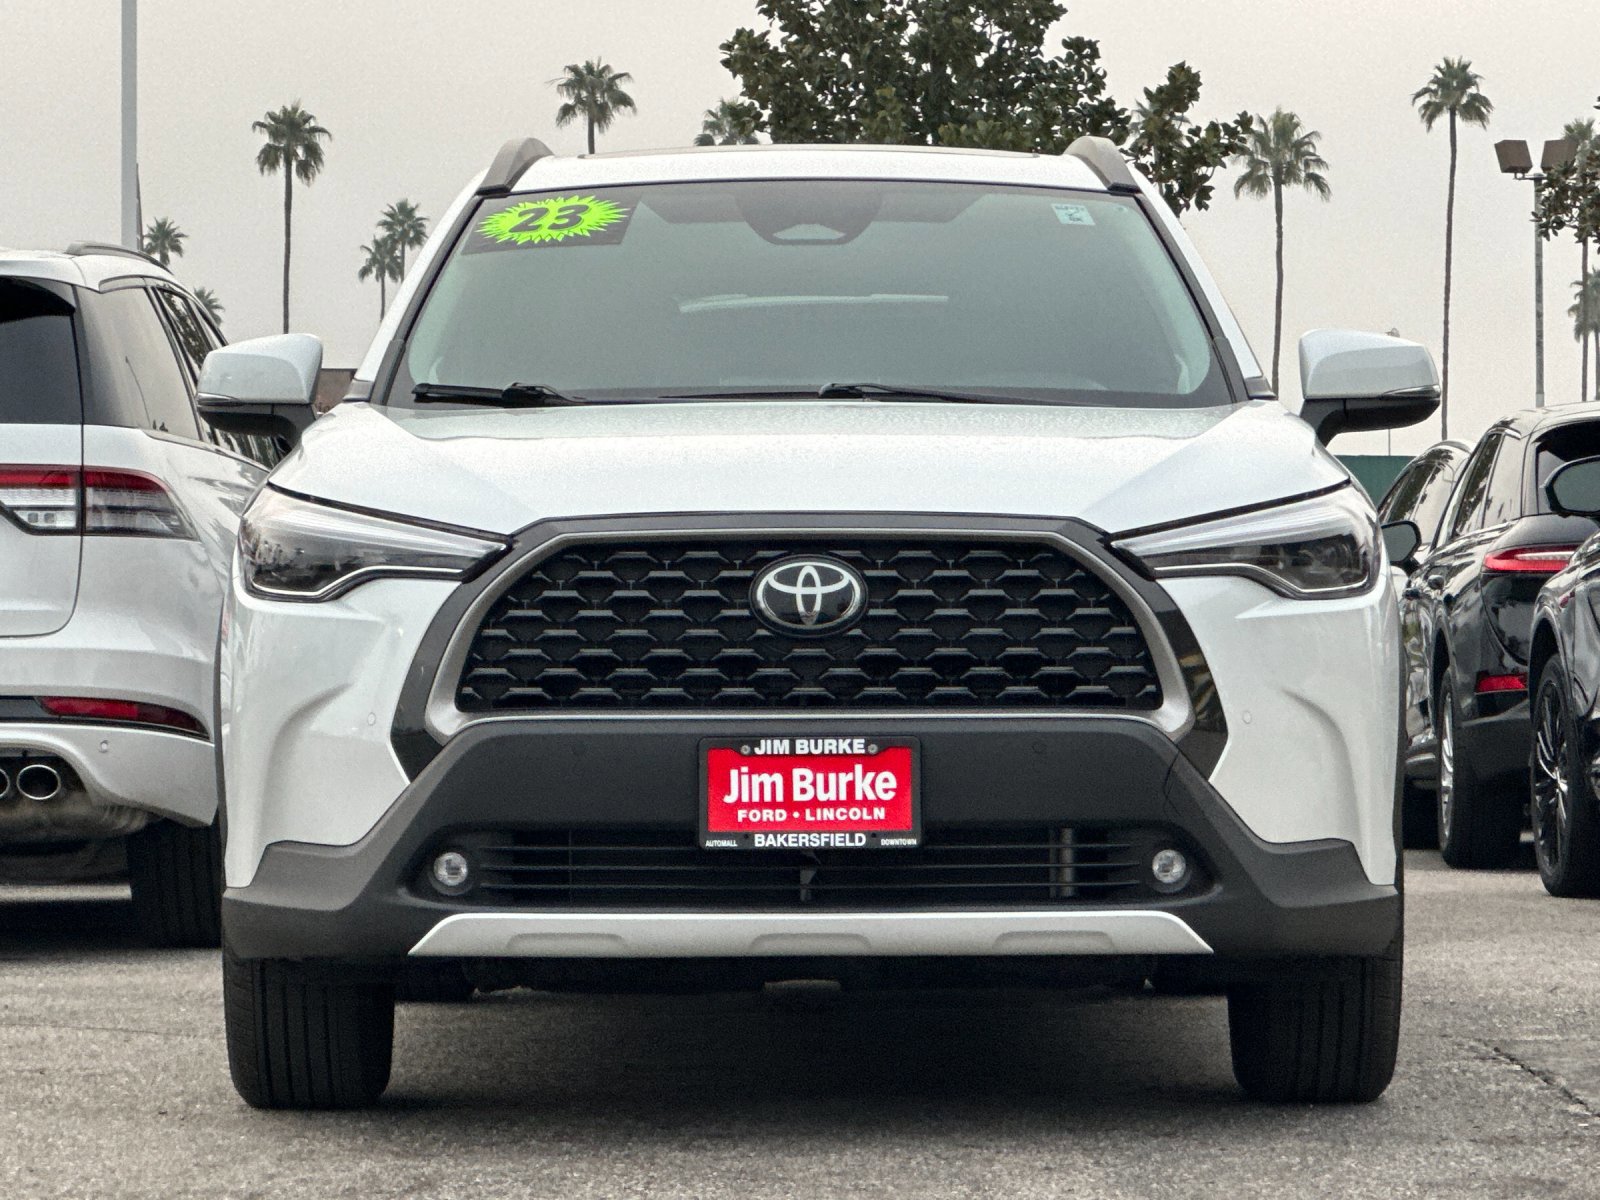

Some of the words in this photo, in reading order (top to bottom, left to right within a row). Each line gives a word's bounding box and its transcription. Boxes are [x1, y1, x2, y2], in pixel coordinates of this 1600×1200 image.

[508, 204, 590, 233] 23
[754, 739, 790, 755] JIM
[795, 738, 866, 755] BURKE
[722, 766, 784, 804] Jim
[792, 764, 898, 802] Burke
[737, 809, 787, 823] FORD
[804, 807, 886, 821] LINCOLN
[705, 839, 738, 848] AUTOMALL
[754, 833, 867, 848] BAKERSFIELD
[880, 838, 917, 846] DOWNTOWN
